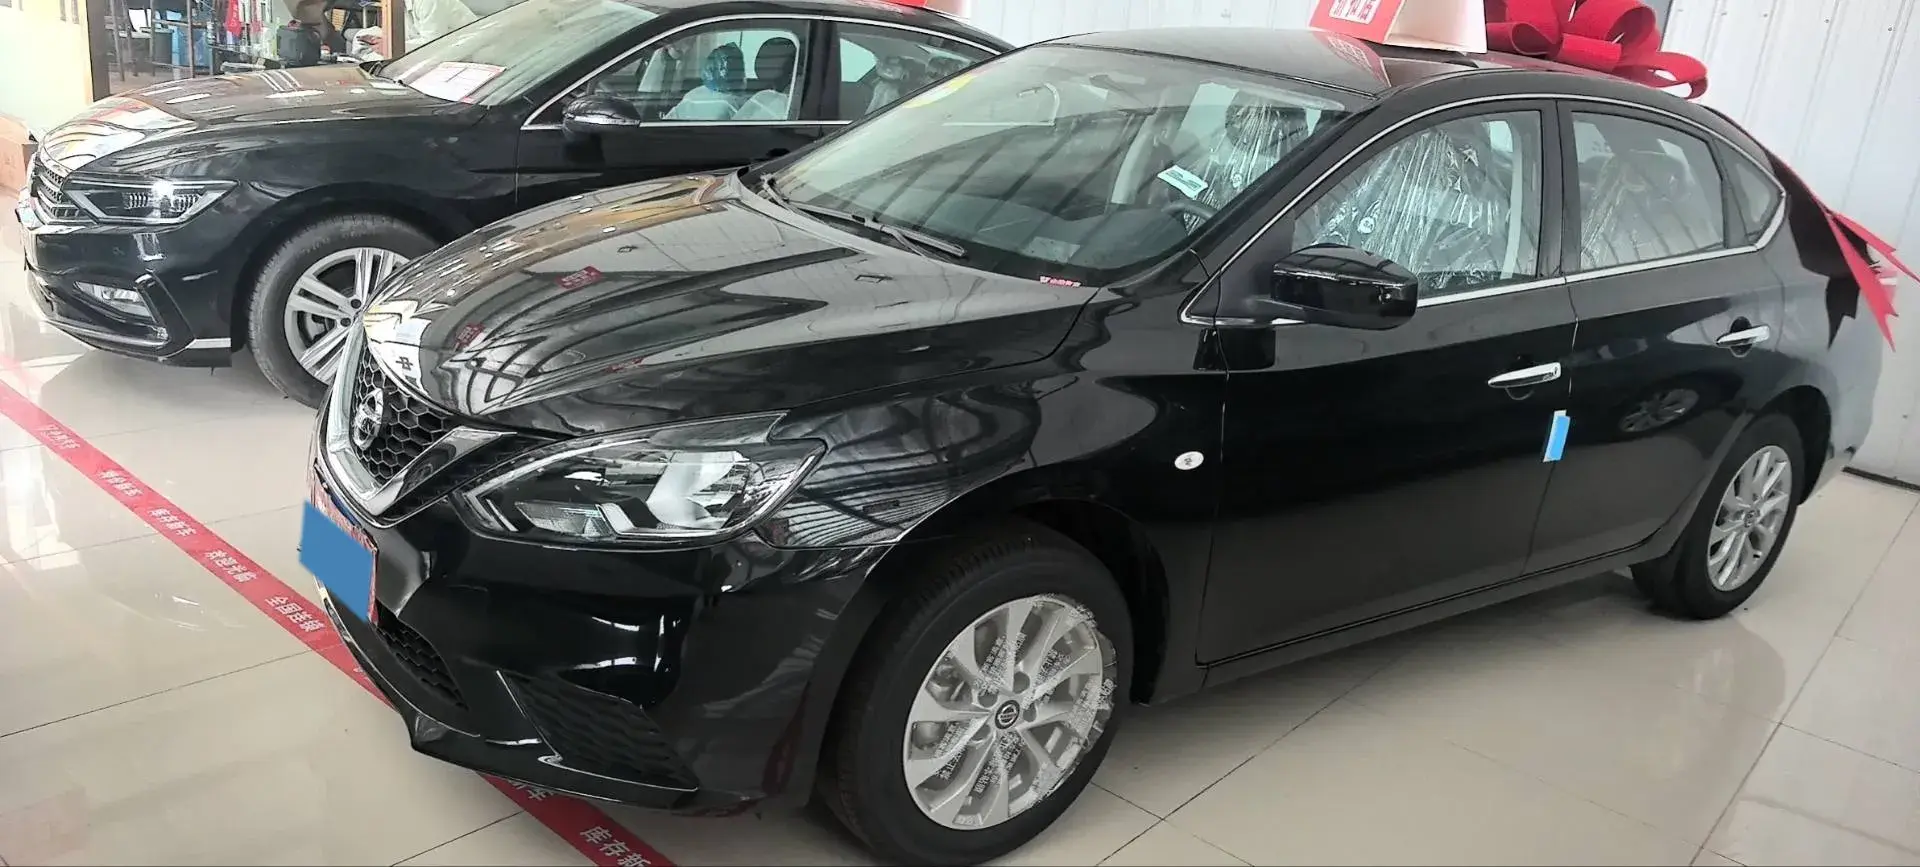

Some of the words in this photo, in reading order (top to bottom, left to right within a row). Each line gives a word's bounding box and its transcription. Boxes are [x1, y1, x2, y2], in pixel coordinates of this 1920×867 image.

[204, 550, 258, 583] 欢迎光临
[264, 595, 326, 632] 全国连锁
